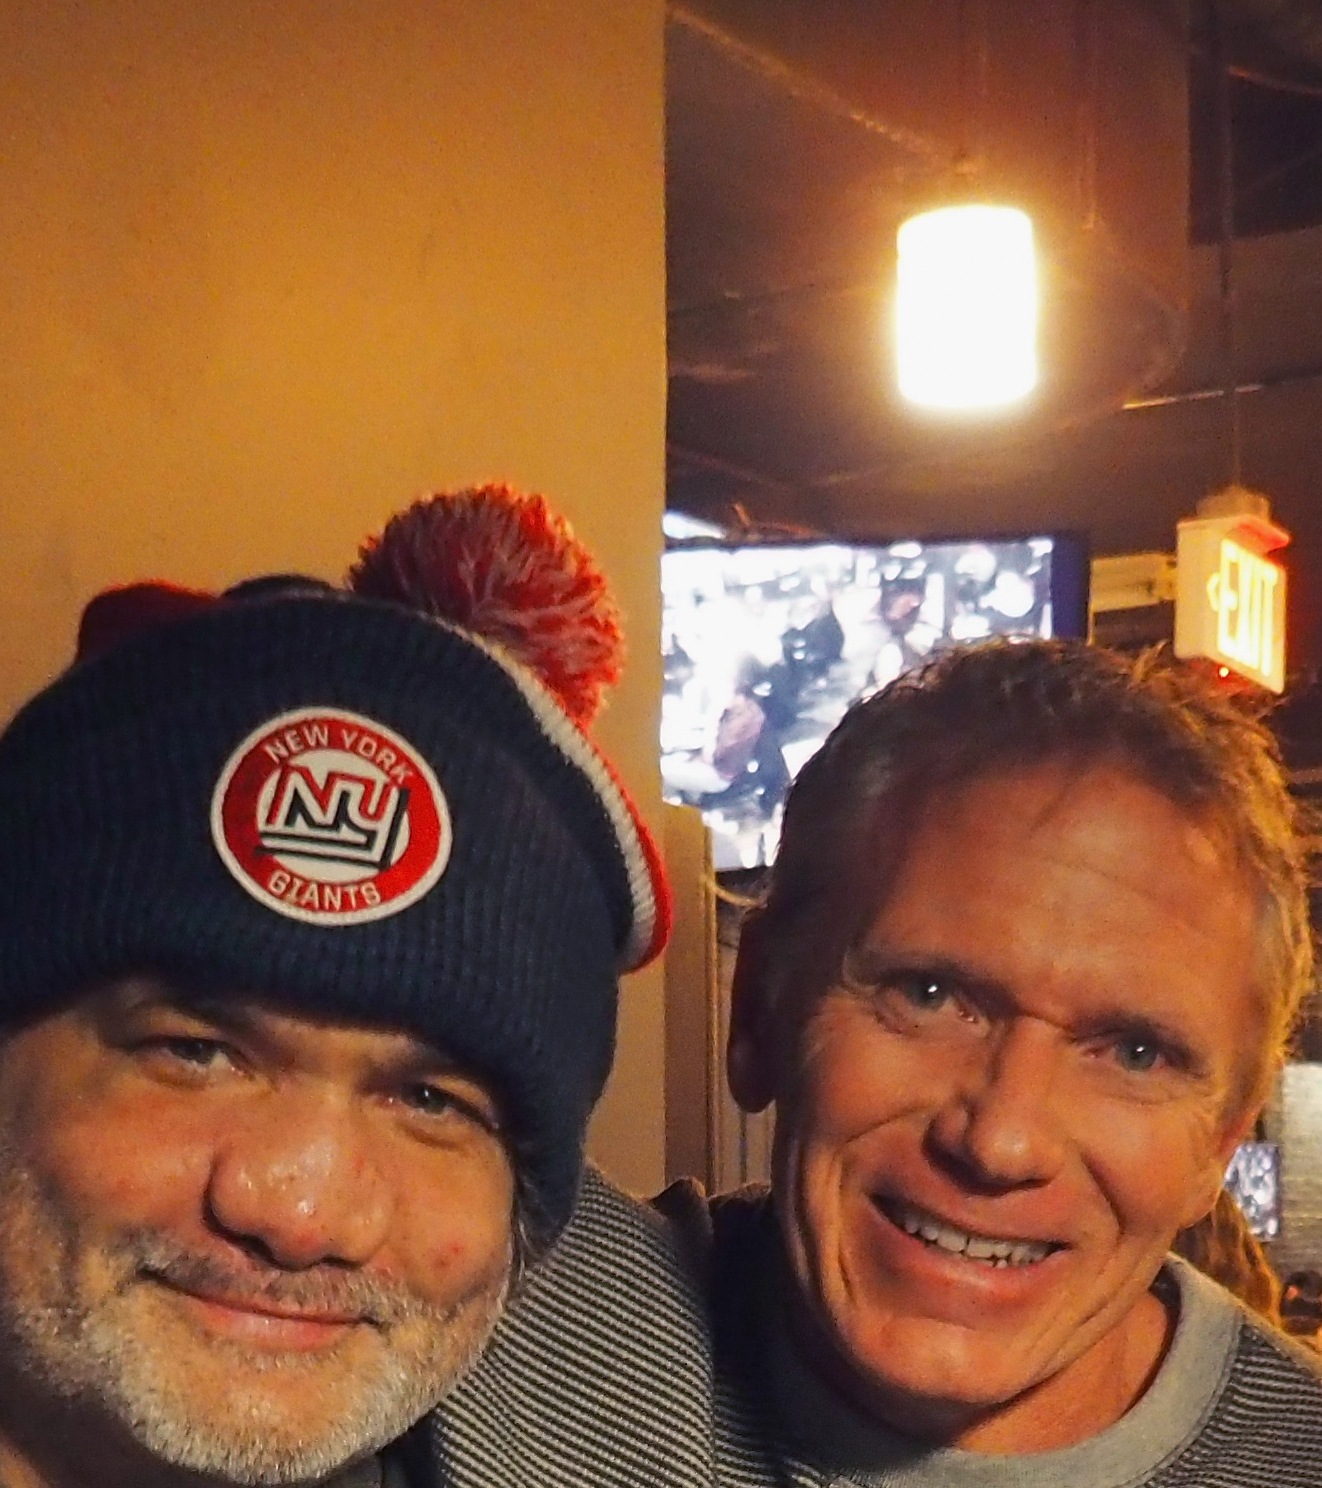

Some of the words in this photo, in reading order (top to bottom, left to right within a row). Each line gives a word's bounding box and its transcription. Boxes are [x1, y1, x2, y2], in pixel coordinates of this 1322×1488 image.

[1218, 539, 1278, 676] EXIT
[265, 725, 328, 764] NEW
[341, 730, 413, 784] YORK
[269, 871, 381, 911] GIANTS
